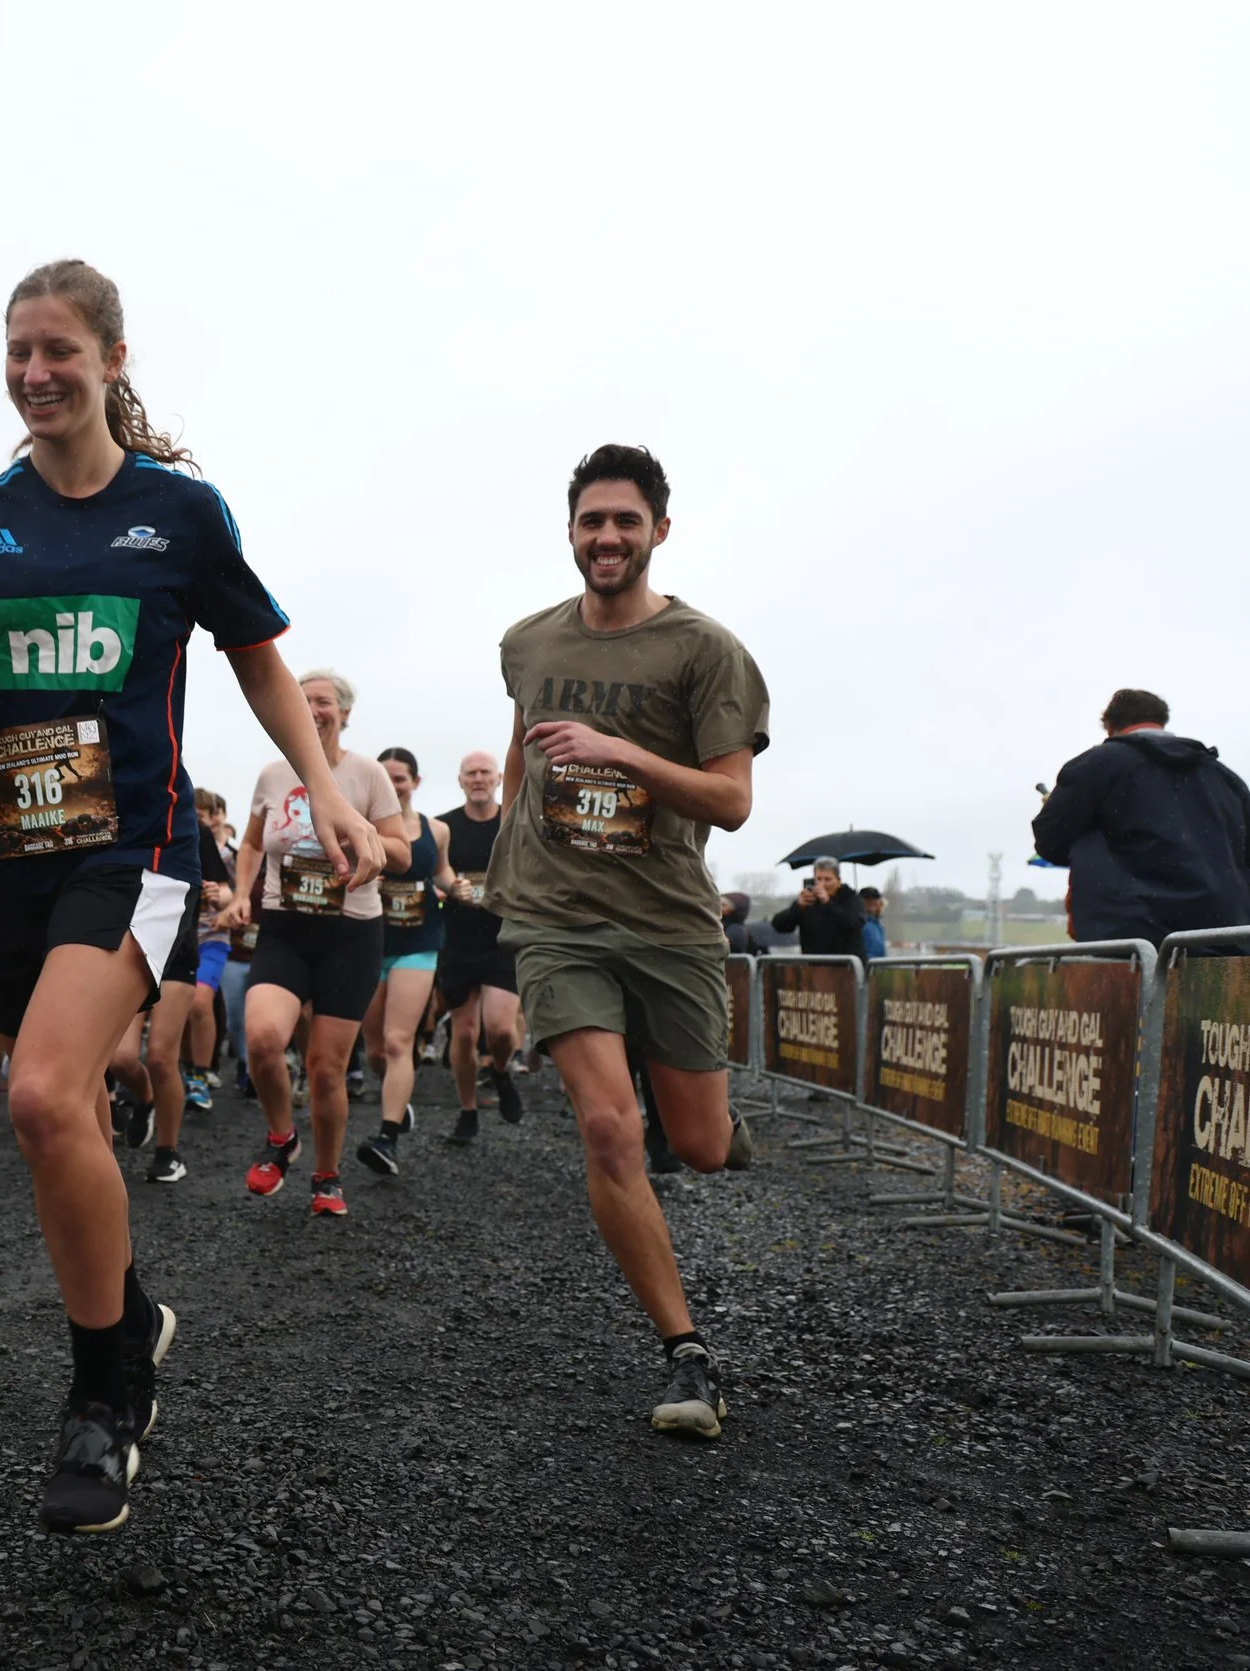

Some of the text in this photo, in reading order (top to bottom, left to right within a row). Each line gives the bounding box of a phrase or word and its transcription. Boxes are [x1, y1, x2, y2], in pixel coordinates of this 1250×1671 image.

[8, 611, 121, 675] nib
[532, 677, 656, 717] ARMY
[19, 730, 36, 740] GUY
[37, 726, 54, 738] AND
[56, 724, 73, 734] GAL
[14, 768, 63, 810] 316
[569, 764, 628, 779] CHALLEN
[21, 809, 66, 830] MAAIKE
[576, 789, 618, 819] 319
[582, 818, 605, 832] MAX
[300, 876, 323, 895] 315
[777, 1009, 839, 1049] CHALLENGE
[1010, 1006, 1103, 1047] TOUGH GUY AND GAL
[1201, 1019, 1250, 1072] TOUGH
[881, 1025, 948, 1074] CHALLENGE
[1007, 1042, 1103, 1116] CHALLENGE
[1194, 1075, 1250, 1168] CHA
[1189, 1162, 1229, 1216] EXTREME
